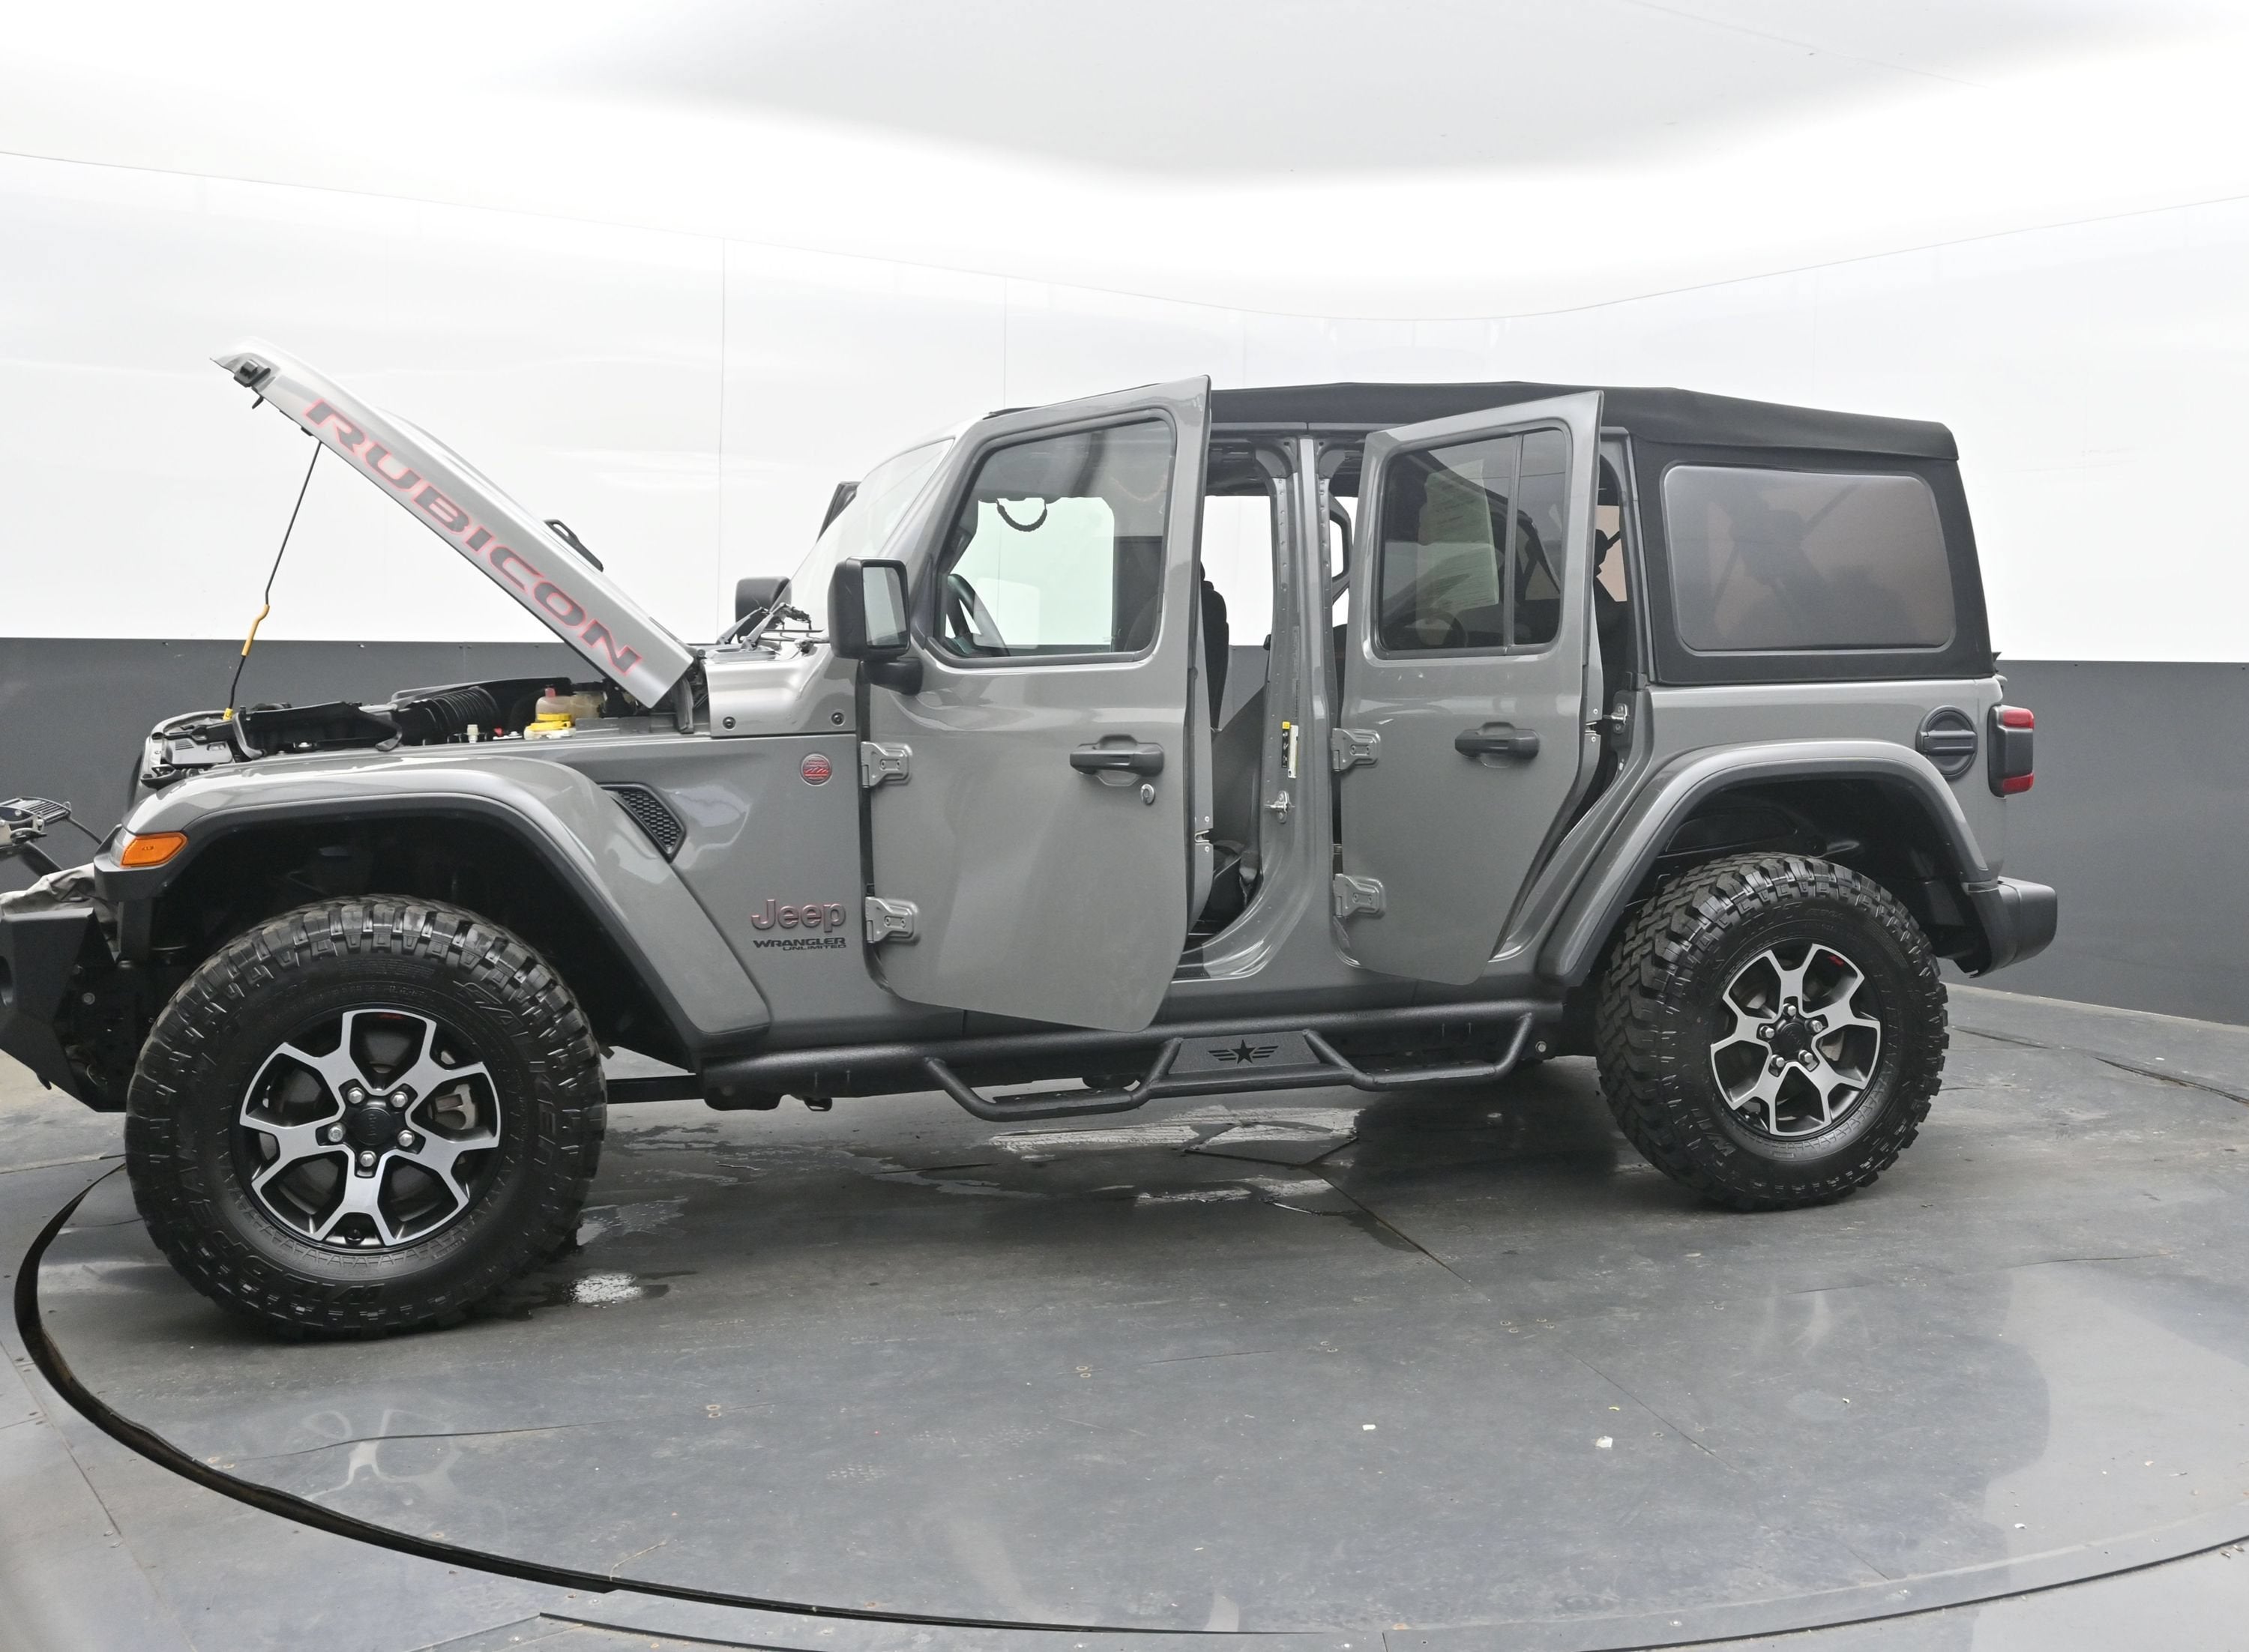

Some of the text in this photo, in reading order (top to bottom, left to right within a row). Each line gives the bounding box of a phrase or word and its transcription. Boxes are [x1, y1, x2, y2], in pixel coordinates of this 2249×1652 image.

[304, 398, 642, 675] RUBICON
[751, 899, 846, 933] Jeep
[752, 937, 846, 949] WRANGLER
